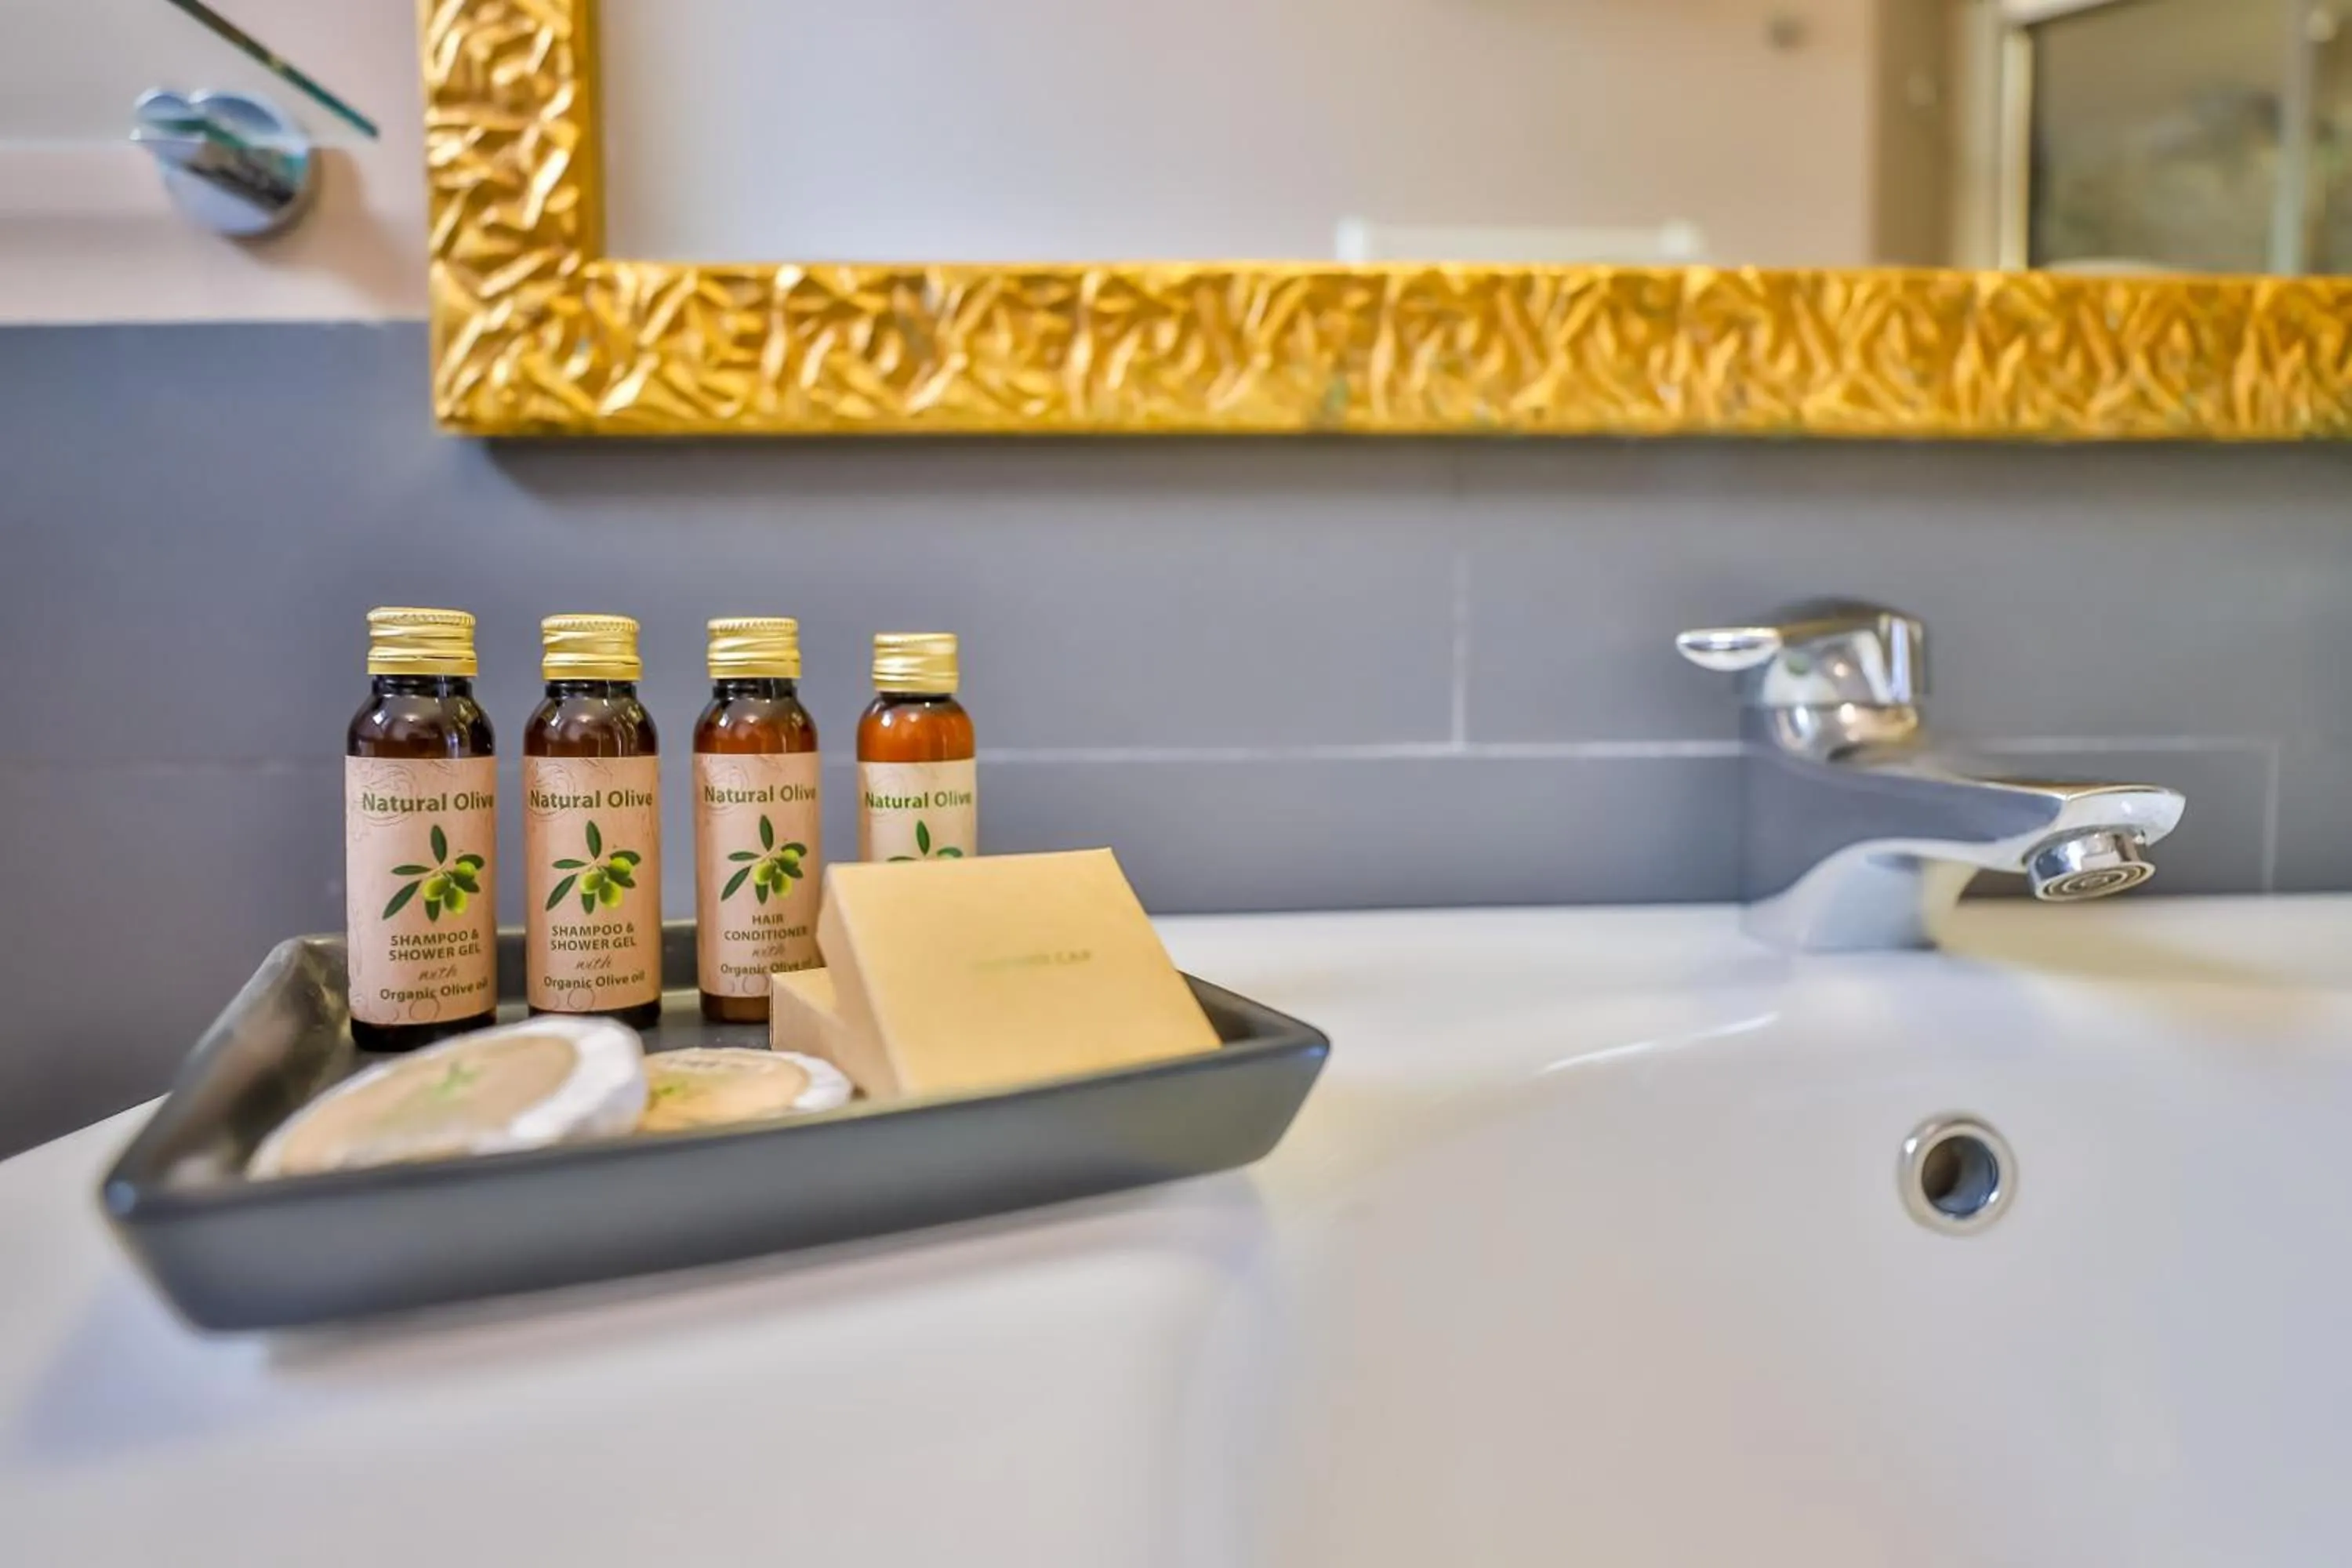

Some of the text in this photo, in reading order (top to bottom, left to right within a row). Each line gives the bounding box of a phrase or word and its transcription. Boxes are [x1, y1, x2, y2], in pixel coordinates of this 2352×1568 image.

[362, 791, 495, 813] Natural Olive
[530, 789, 653, 809] Natural Olive
[704, 785, 774, 803] Natural
[865, 791, 929, 809] Natural
[752, 913, 784, 925] HAIR
[390, 928, 480, 946] SHAMPOO &
[551, 923, 635, 937] SHAMPOO &
[389, 942, 481, 961] SHOWER GEL
[550, 936, 637, 951] SHOWER GEL
[720, 964, 768, 977] Organic
[543, 969, 646, 991] Organic Olive oil
[379, 986, 437, 1003] Organic
[440, 982, 474, 996] Olive
